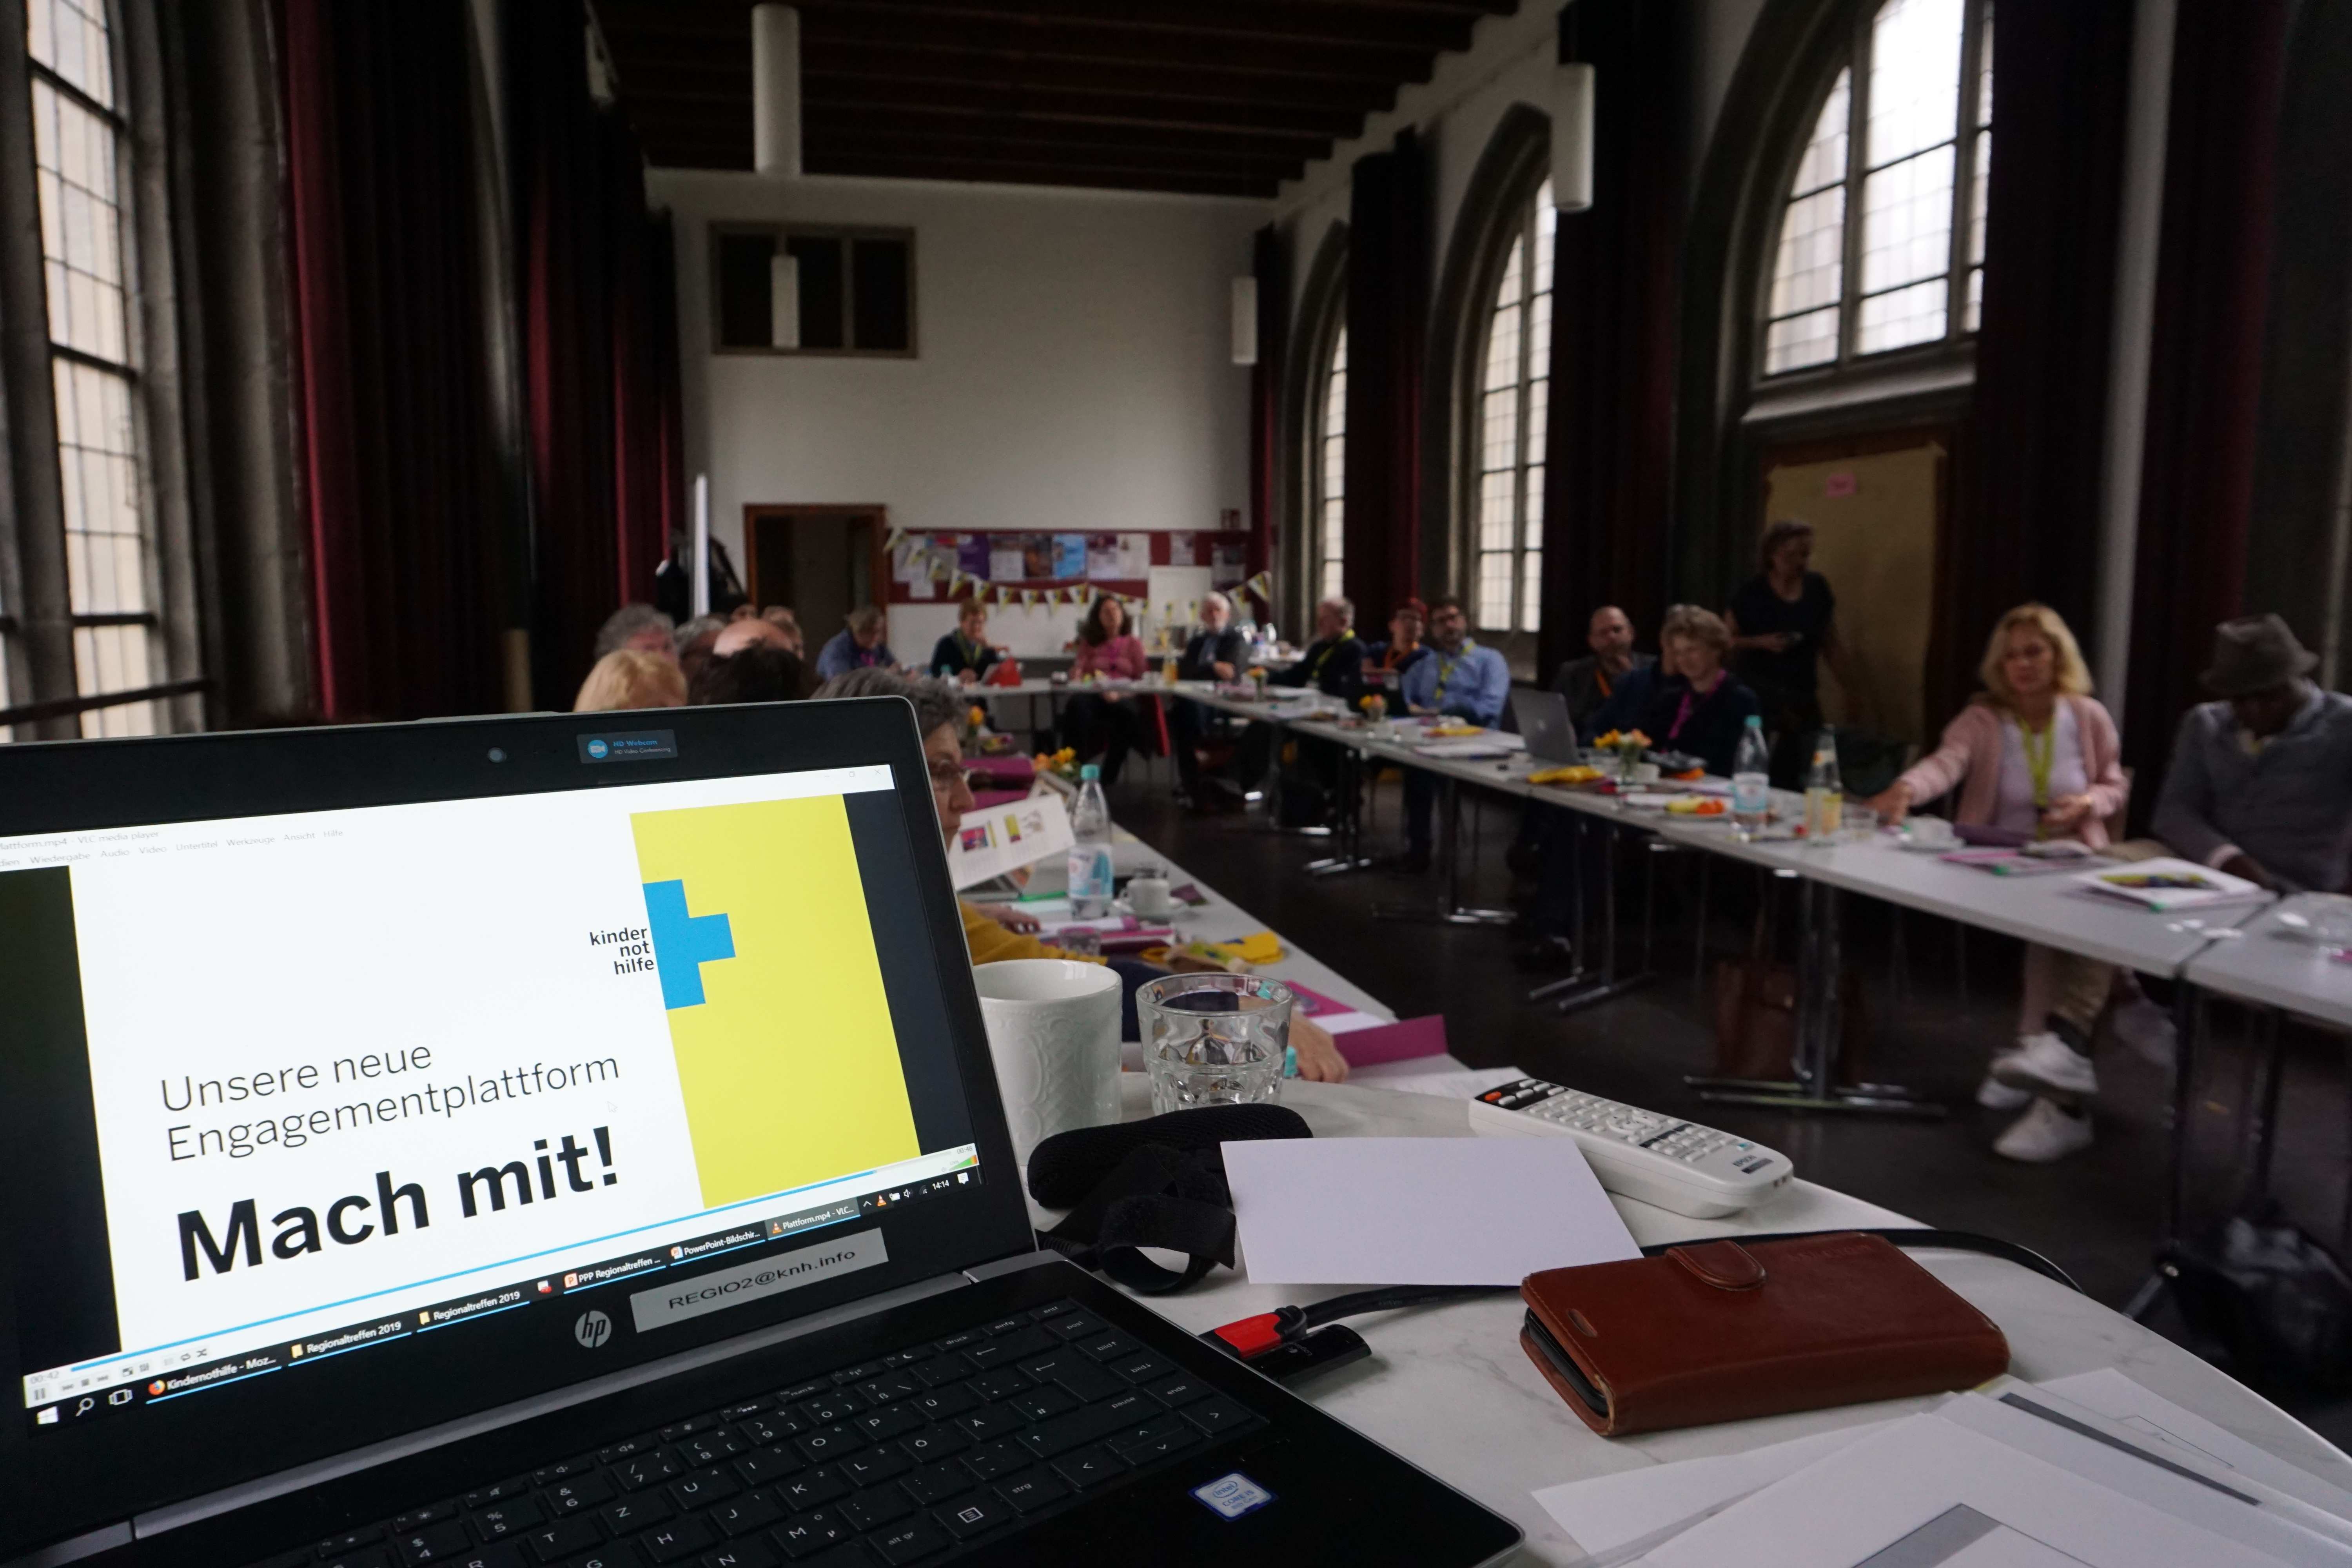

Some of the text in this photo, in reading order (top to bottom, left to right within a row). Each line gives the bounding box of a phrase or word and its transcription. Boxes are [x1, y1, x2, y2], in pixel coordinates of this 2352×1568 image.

[99, 833, 128, 842] media
[131, 831, 159, 841] player
[30, 853, 91, 864] Wiedergabe
[100, 849, 130, 858] Audio
[139, 846, 167, 854] Video
[176, 841, 217, 851] Untertitel
[226, 837, 275, 846] Werkzeuge
[283, 833, 315, 841] Ansicht
[590, 927, 647, 946] kinder
[620, 940, 650, 957] not
[614, 957, 654, 975] hilfe
[161, 1045, 432, 1112] Unsere neue
[168, 1056, 620, 1161] Engagementplattform
[932, 1180, 949, 1190] 14:14
[177, 1126, 618, 1281] Mach mit!
[782, 1211, 831, 1230] Plattform.mp4
[578, 1272, 593, 1283] PPP
[595, 1258, 653, 1278] Regionaltreffen
[668, 1250, 855, 1309] REGIO2@knh.info
[433, 1291, 520, 1321] Regionaltreffen 2019
[582, 1311, 606, 1348] hp
[307, 1321, 401, 1354] Regionaltreffen 2019
[946, 1336, 968, 1345] druck
[1096, 1341, 1112, 1351] bild
[1130, 1363, 1145, 1373] bild
[167, 1363, 238, 1390] Kindernothilfe
[1167, 1386, 1187, 1395] ende
[1111, 1397, 1135, 1408] pause
[869, 1419, 880, 1427] P
[634, 1474, 643, 1482] 7
[684, 1483, 698, 1492] U
[791, 1484, 808, 1494] K
[1012, 1483, 1032, 1493] strg
[566, 1498, 578, 1506] 6
[616, 1506, 631, 1517] Z
[729, 1509, 738, 1518] J
[494, 1523, 506, 1532] 5
[788, 1527, 807, 1539] M
[543, 1533, 554, 1542] T
[657, 1533, 673, 1544] H
[719, 1554, 736, 1566] N
